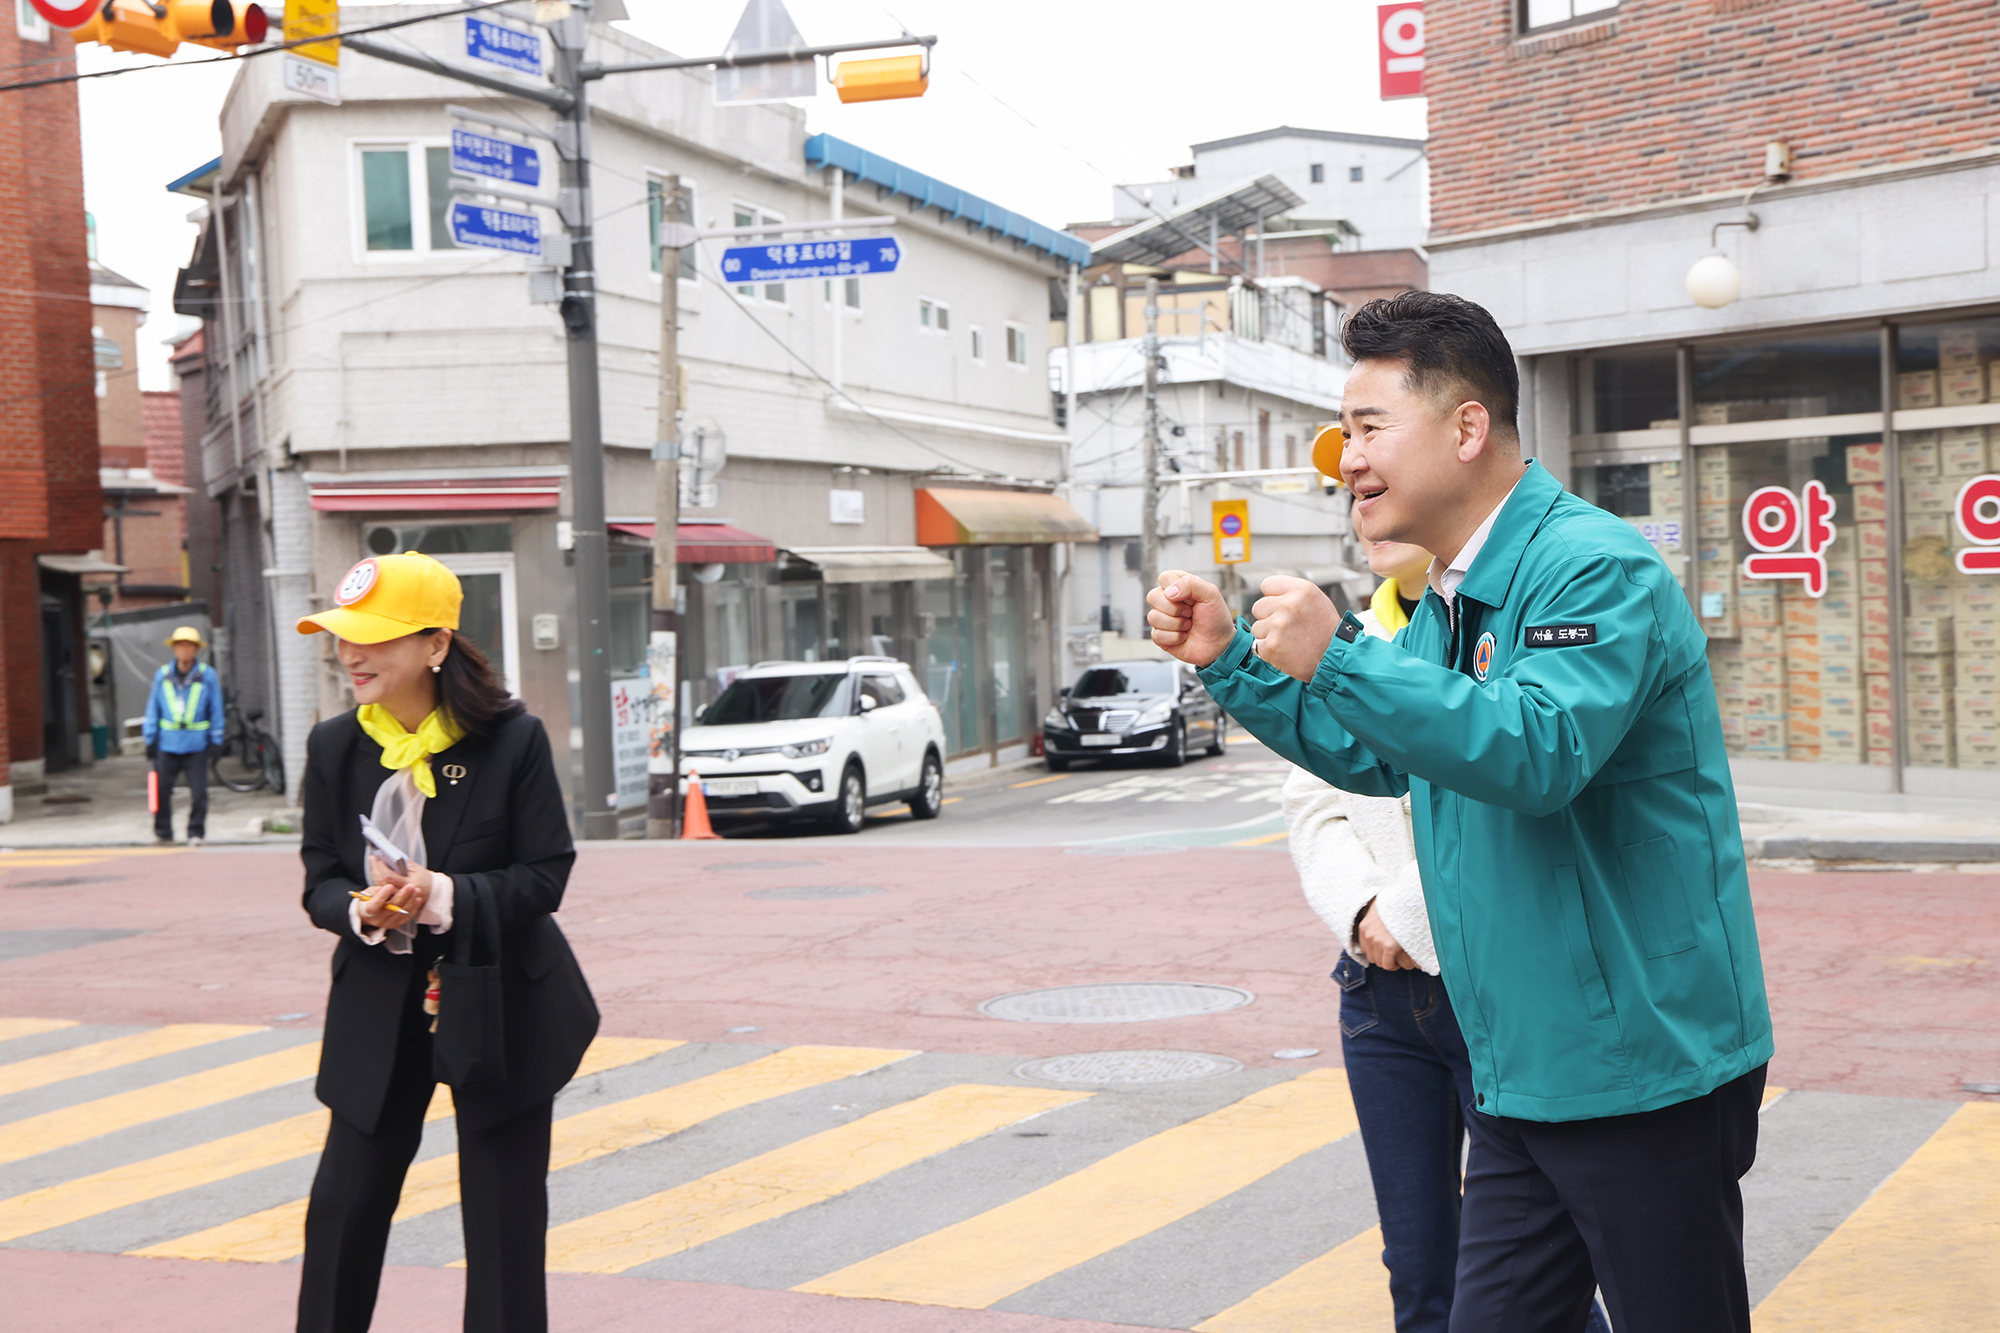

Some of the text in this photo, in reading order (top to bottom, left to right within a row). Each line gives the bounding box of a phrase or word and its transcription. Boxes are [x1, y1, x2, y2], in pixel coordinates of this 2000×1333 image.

[295, 63, 329, 93] 50m
[766, 241, 852, 265] 덕릉로60길
[1745, 483, 1833, 595] 약
[344, 567, 372, 591] 30
[1532, 628, 1589, 642] 서울 도봉구
